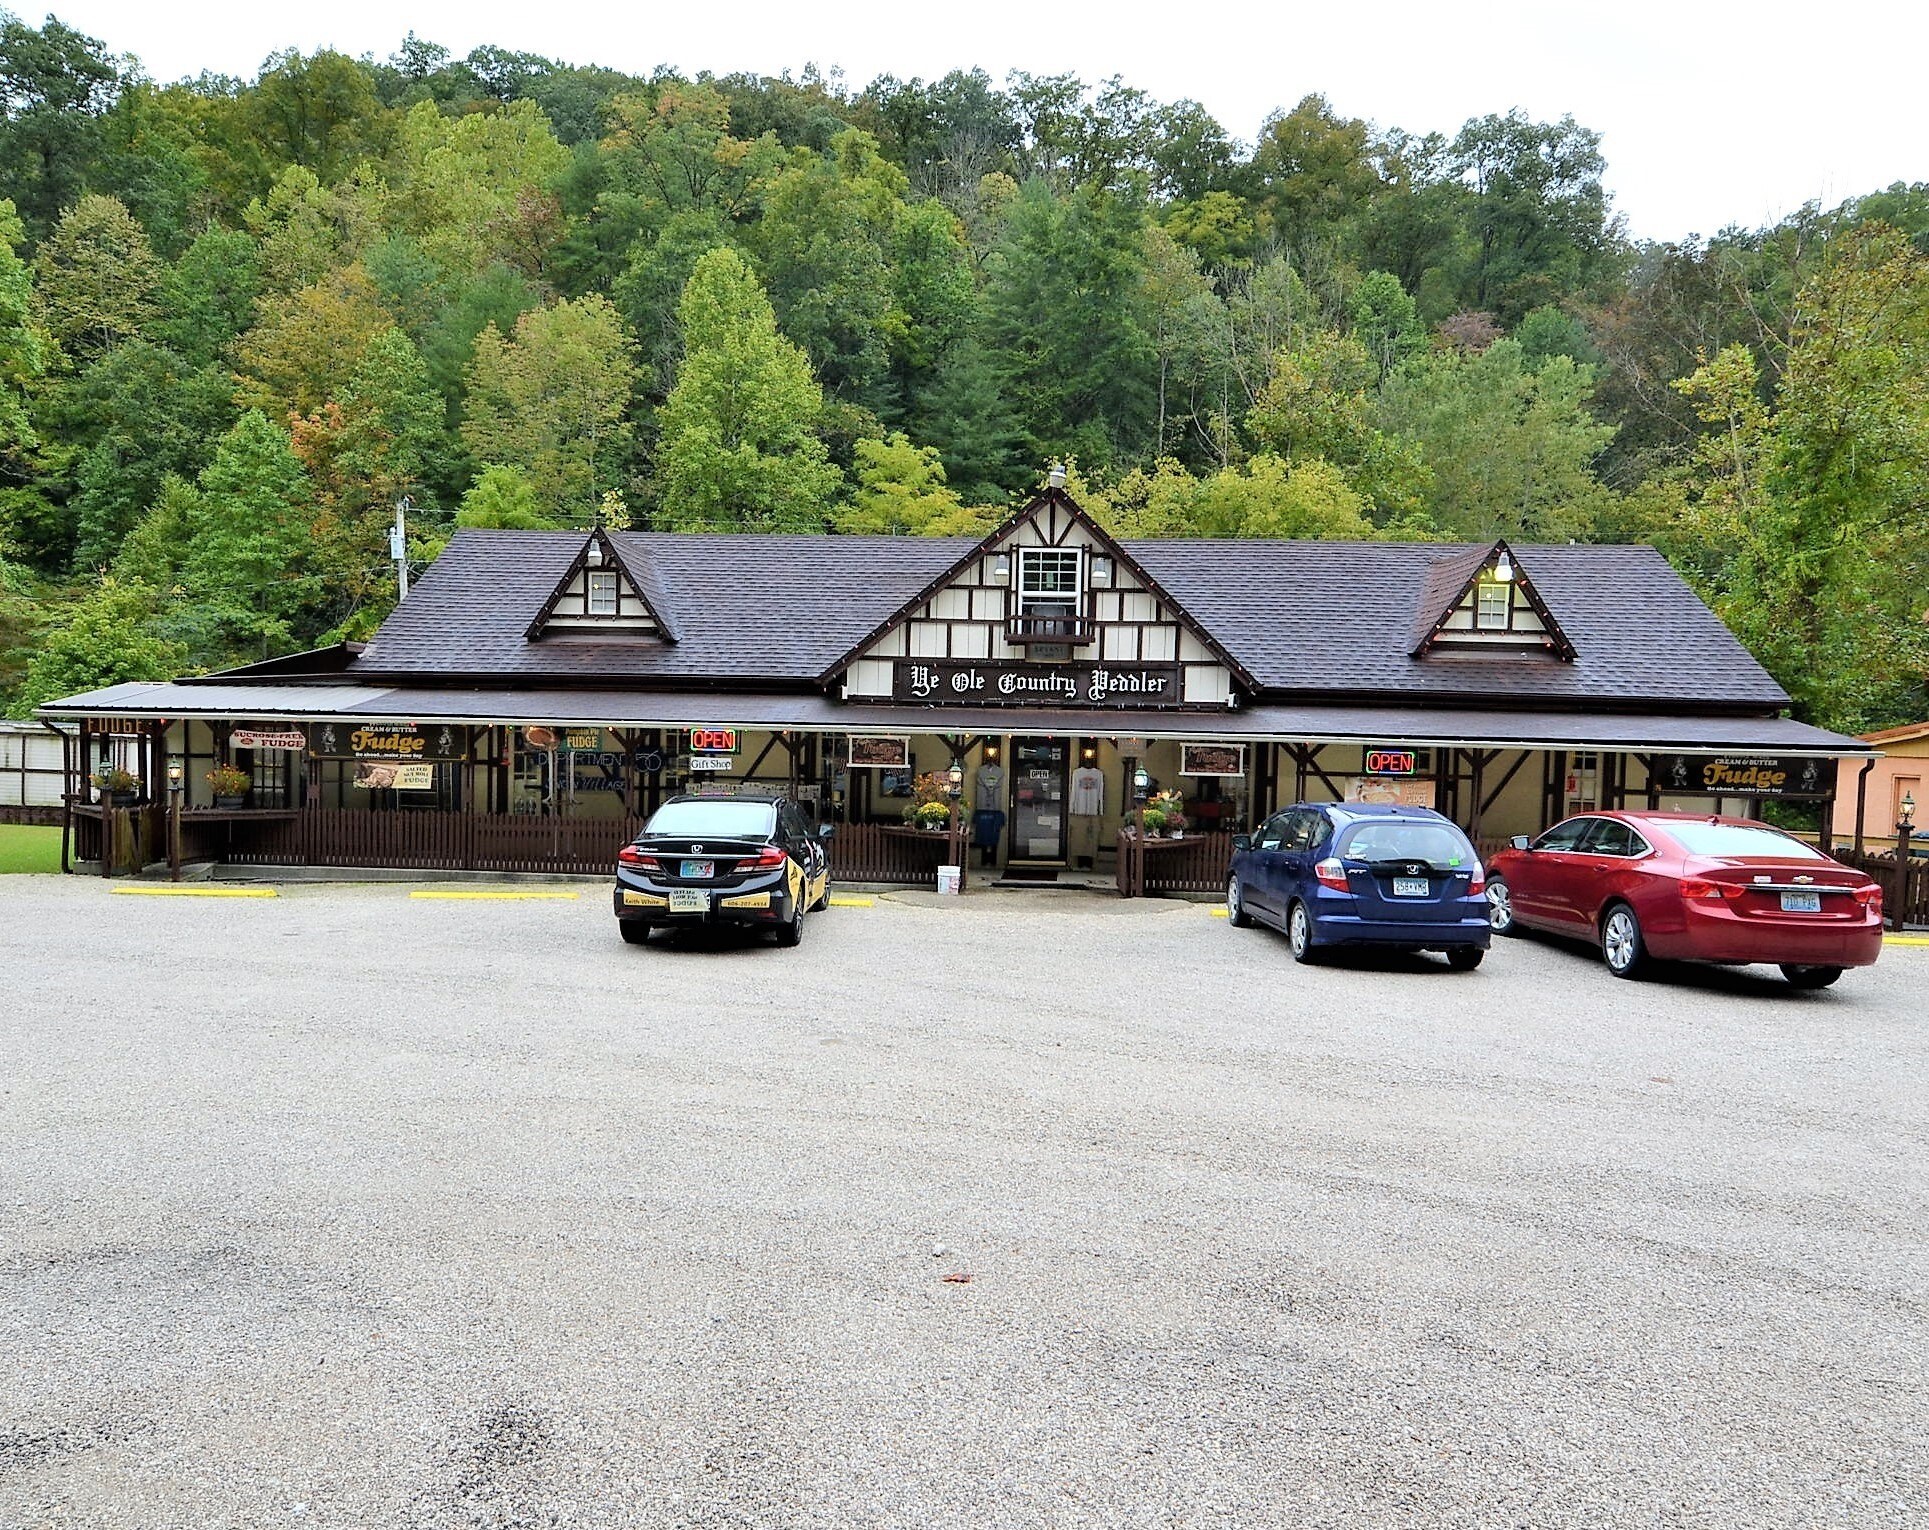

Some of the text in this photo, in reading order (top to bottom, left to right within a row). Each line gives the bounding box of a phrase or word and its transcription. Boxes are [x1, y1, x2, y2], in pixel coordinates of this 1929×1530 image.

[911, 665, 1167, 700] Ye Ole Country Peddler
[261, 739, 304, 748] FUDGE
[351, 730, 425, 754] Fudge
[567, 736, 598, 748] FUDGE
[693, 731, 732, 748] OPEN
[691, 759, 731, 770] Gift Shop
[1370, 754, 1411, 771] OPEN
[1703, 763, 1786, 788] Fudge
